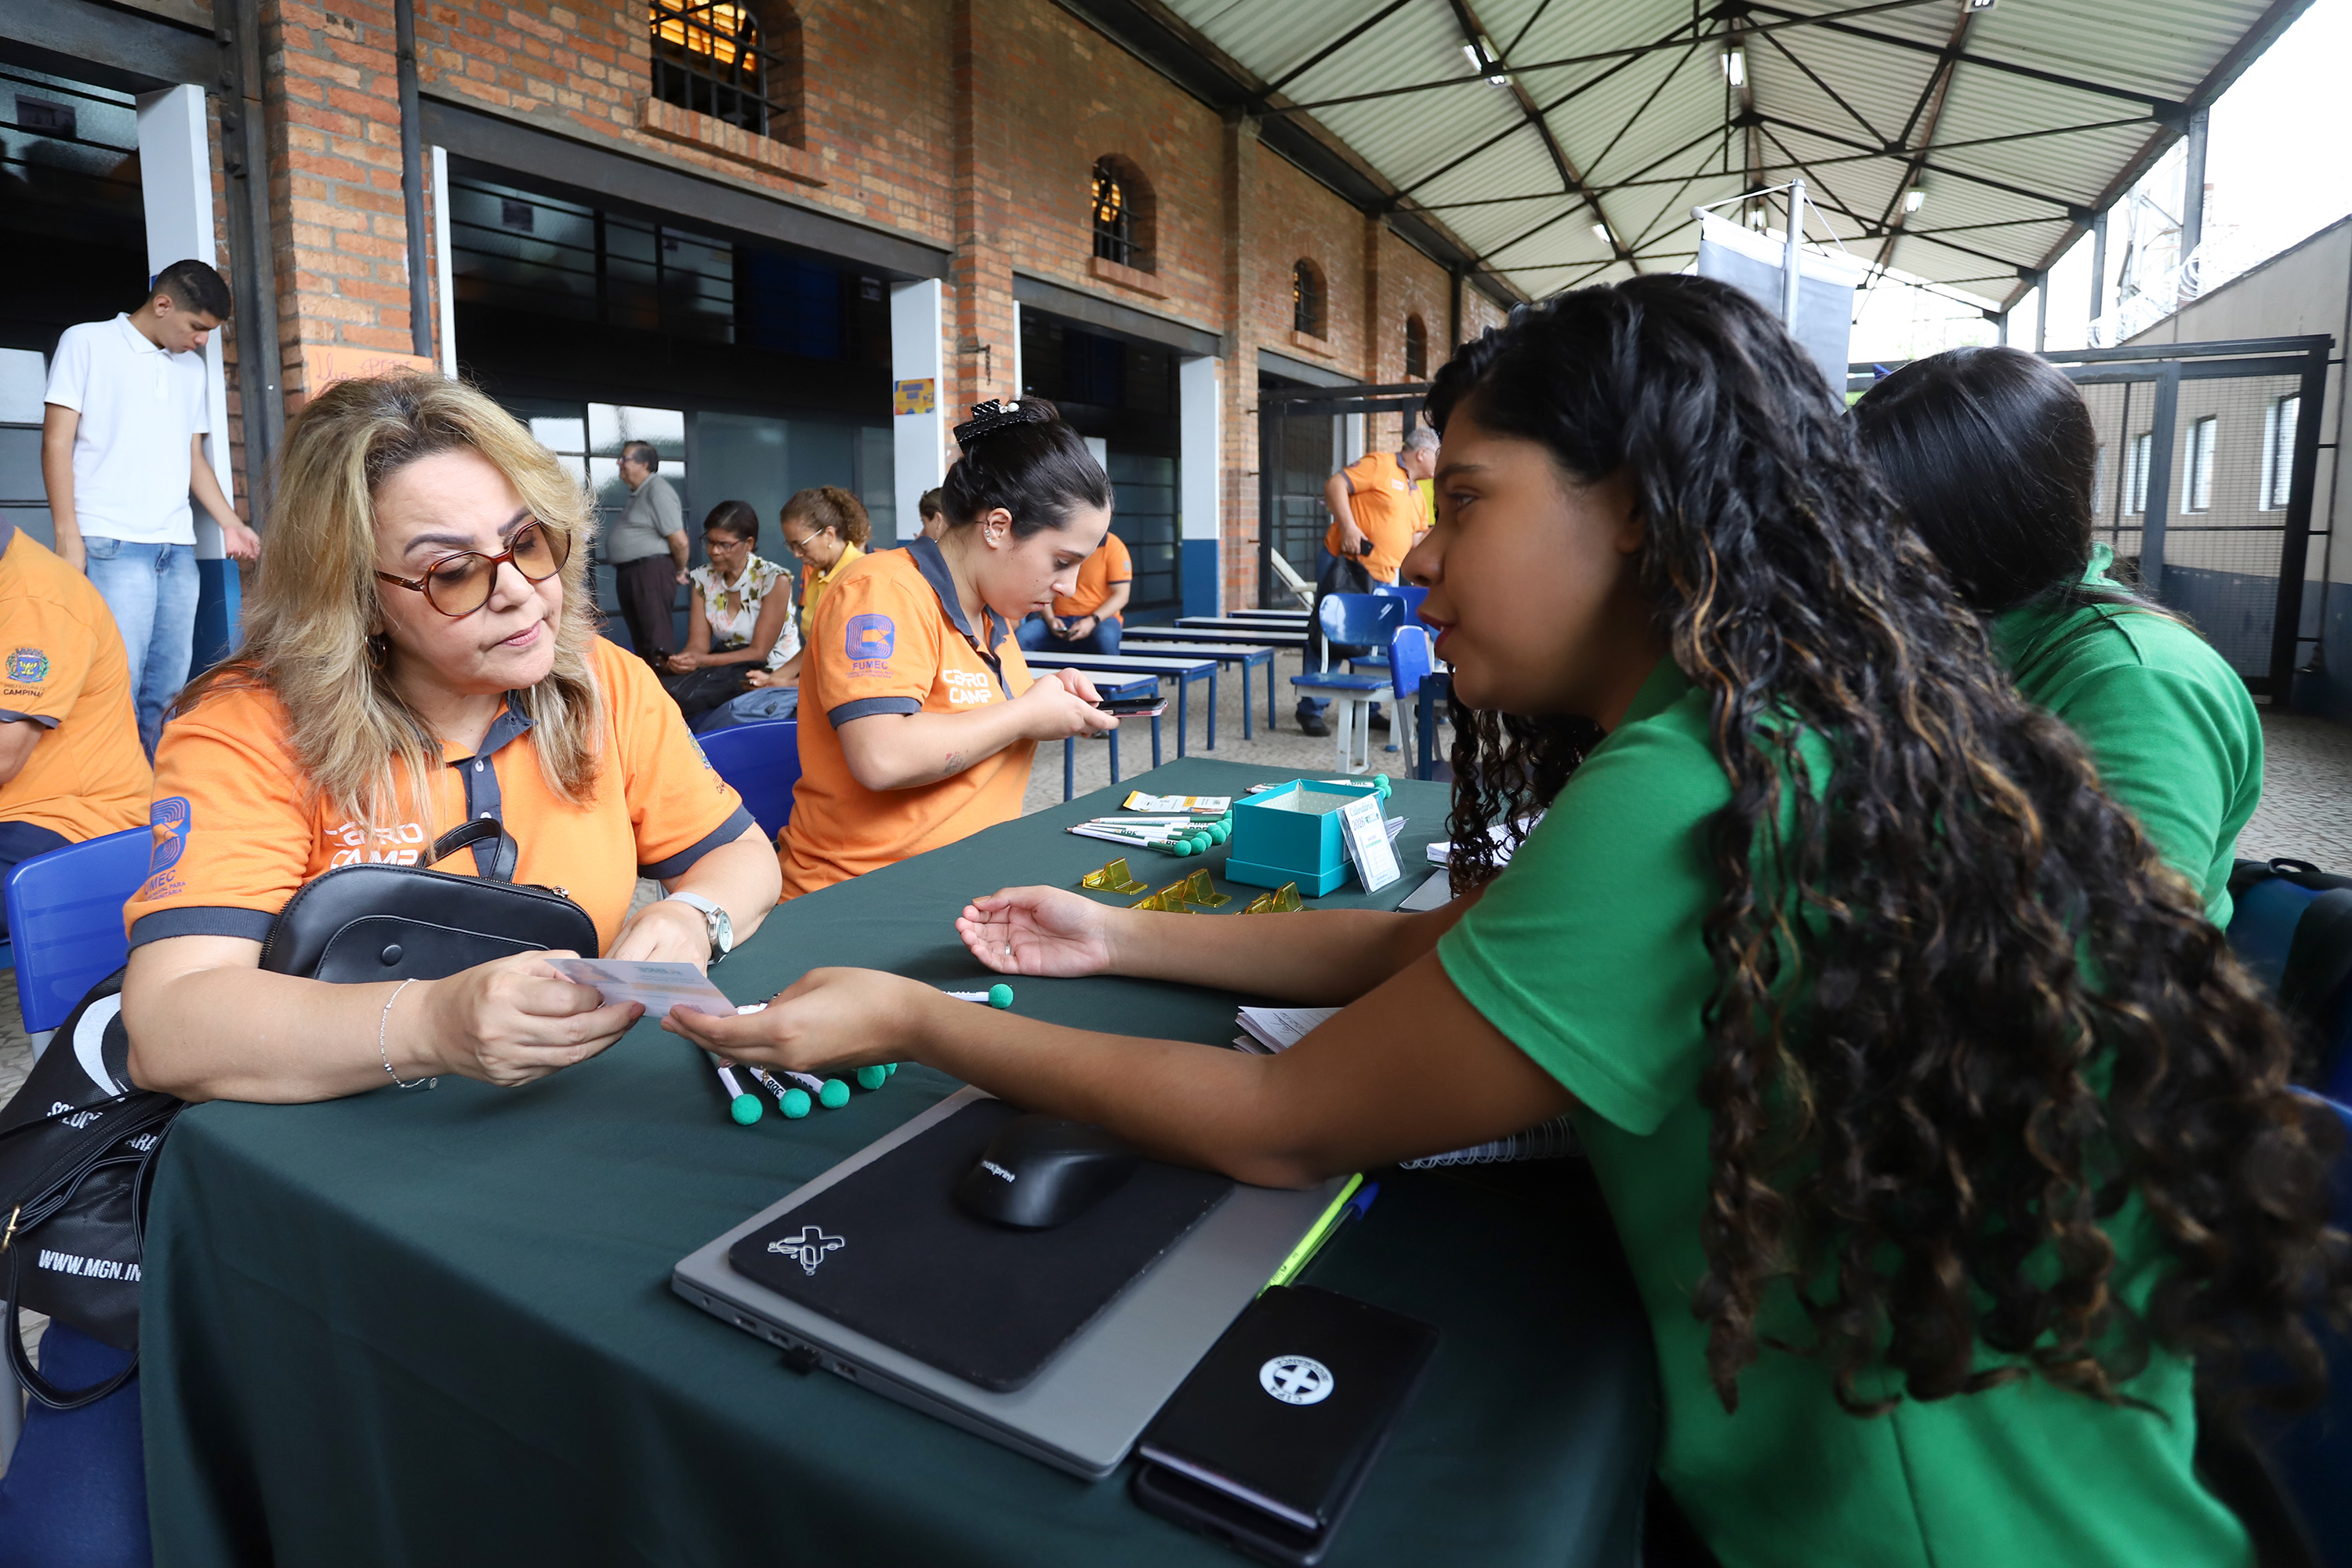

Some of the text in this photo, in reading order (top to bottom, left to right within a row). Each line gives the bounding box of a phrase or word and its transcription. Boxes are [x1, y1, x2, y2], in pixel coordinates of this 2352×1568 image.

[853, 660, 889, 670] FUMEC
[949, 687, 993, 705] CAMP
[144, 869, 176, 895] UMEC
